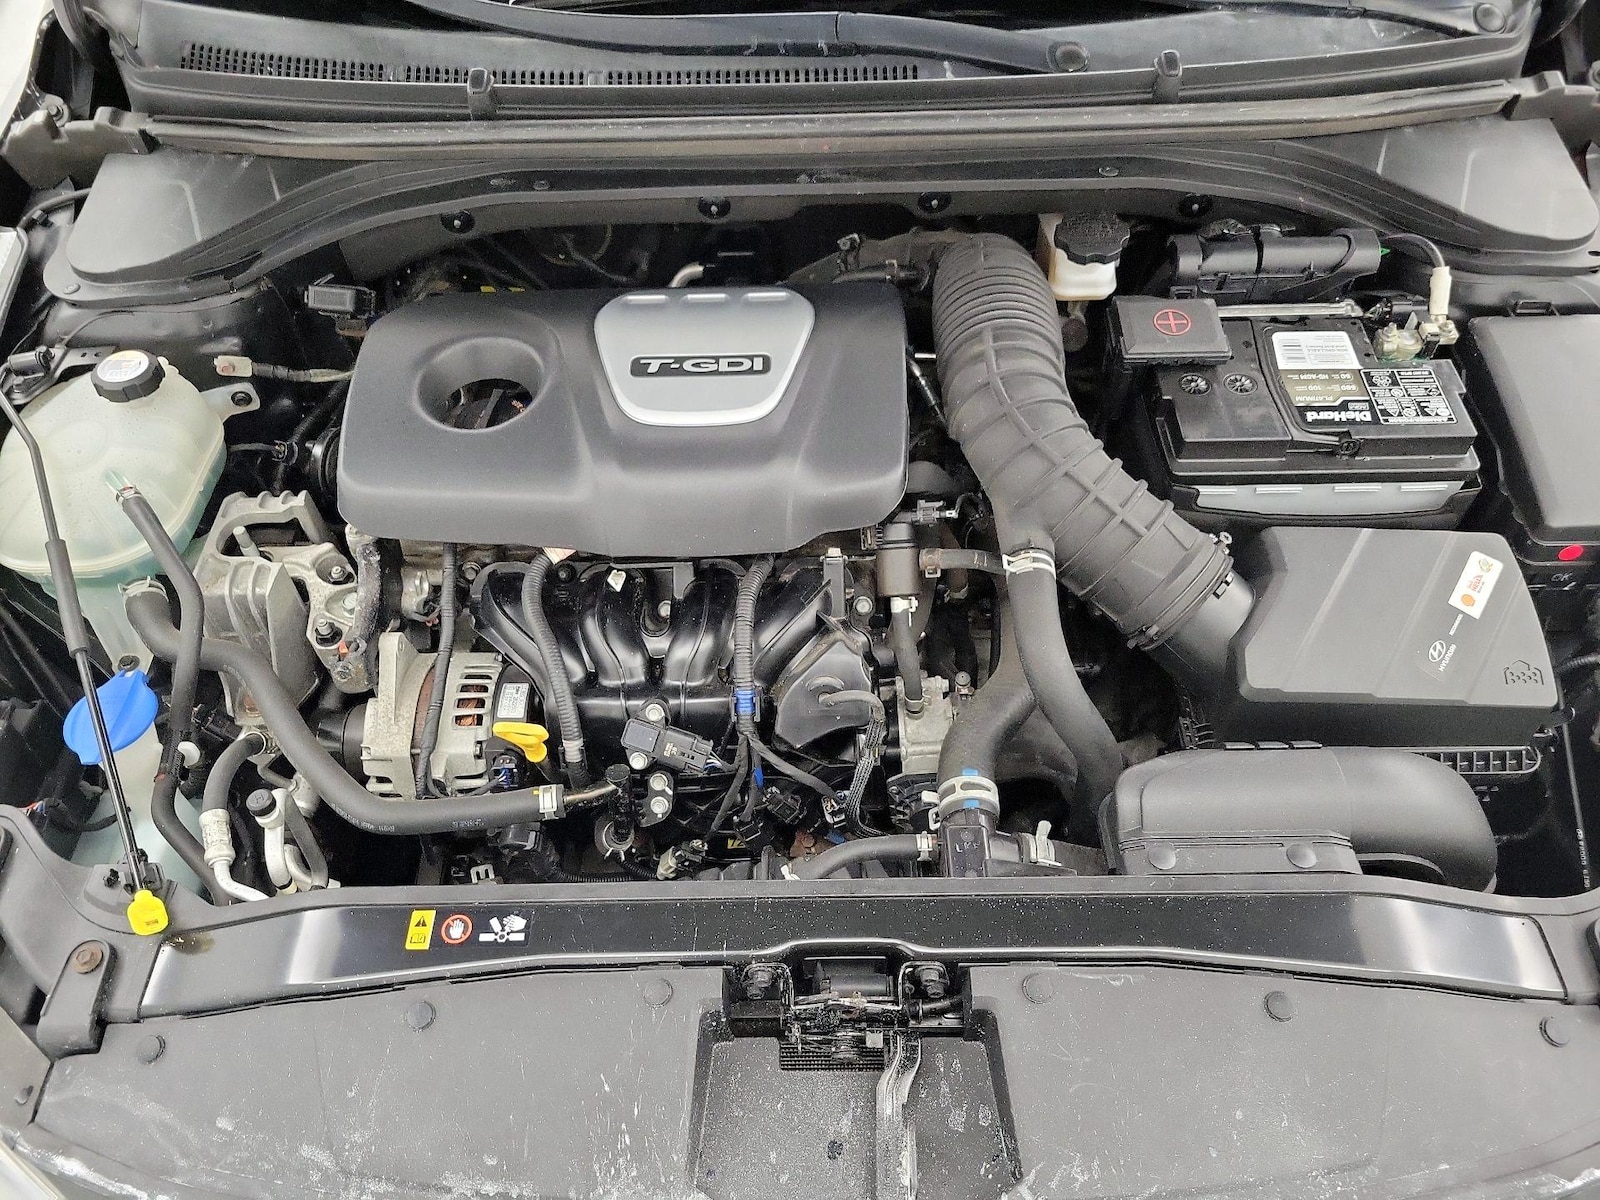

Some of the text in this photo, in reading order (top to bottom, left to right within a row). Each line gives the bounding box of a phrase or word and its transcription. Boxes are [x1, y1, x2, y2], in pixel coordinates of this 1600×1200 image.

[640, 356, 764, 374] T-GDI
[1305, 410, 1372, 422] DieHard
[1438, 643, 1457, 672] HYUNDAI
